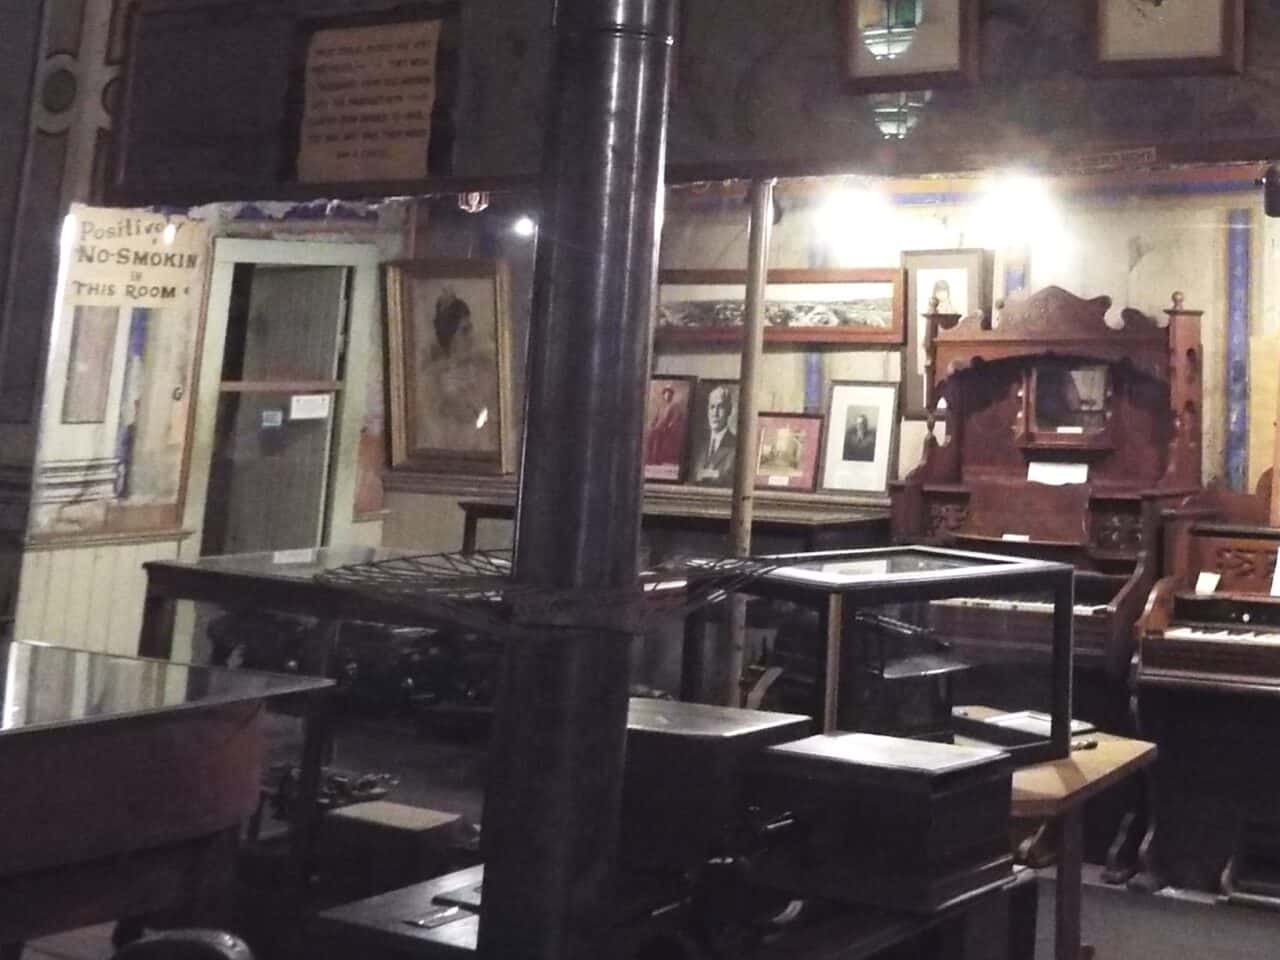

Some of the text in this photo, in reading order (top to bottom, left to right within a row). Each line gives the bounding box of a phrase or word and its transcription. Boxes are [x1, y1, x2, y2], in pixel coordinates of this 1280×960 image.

[80, 217, 184, 240] Positivey
[72, 279, 176, 300] THIS ROOM
